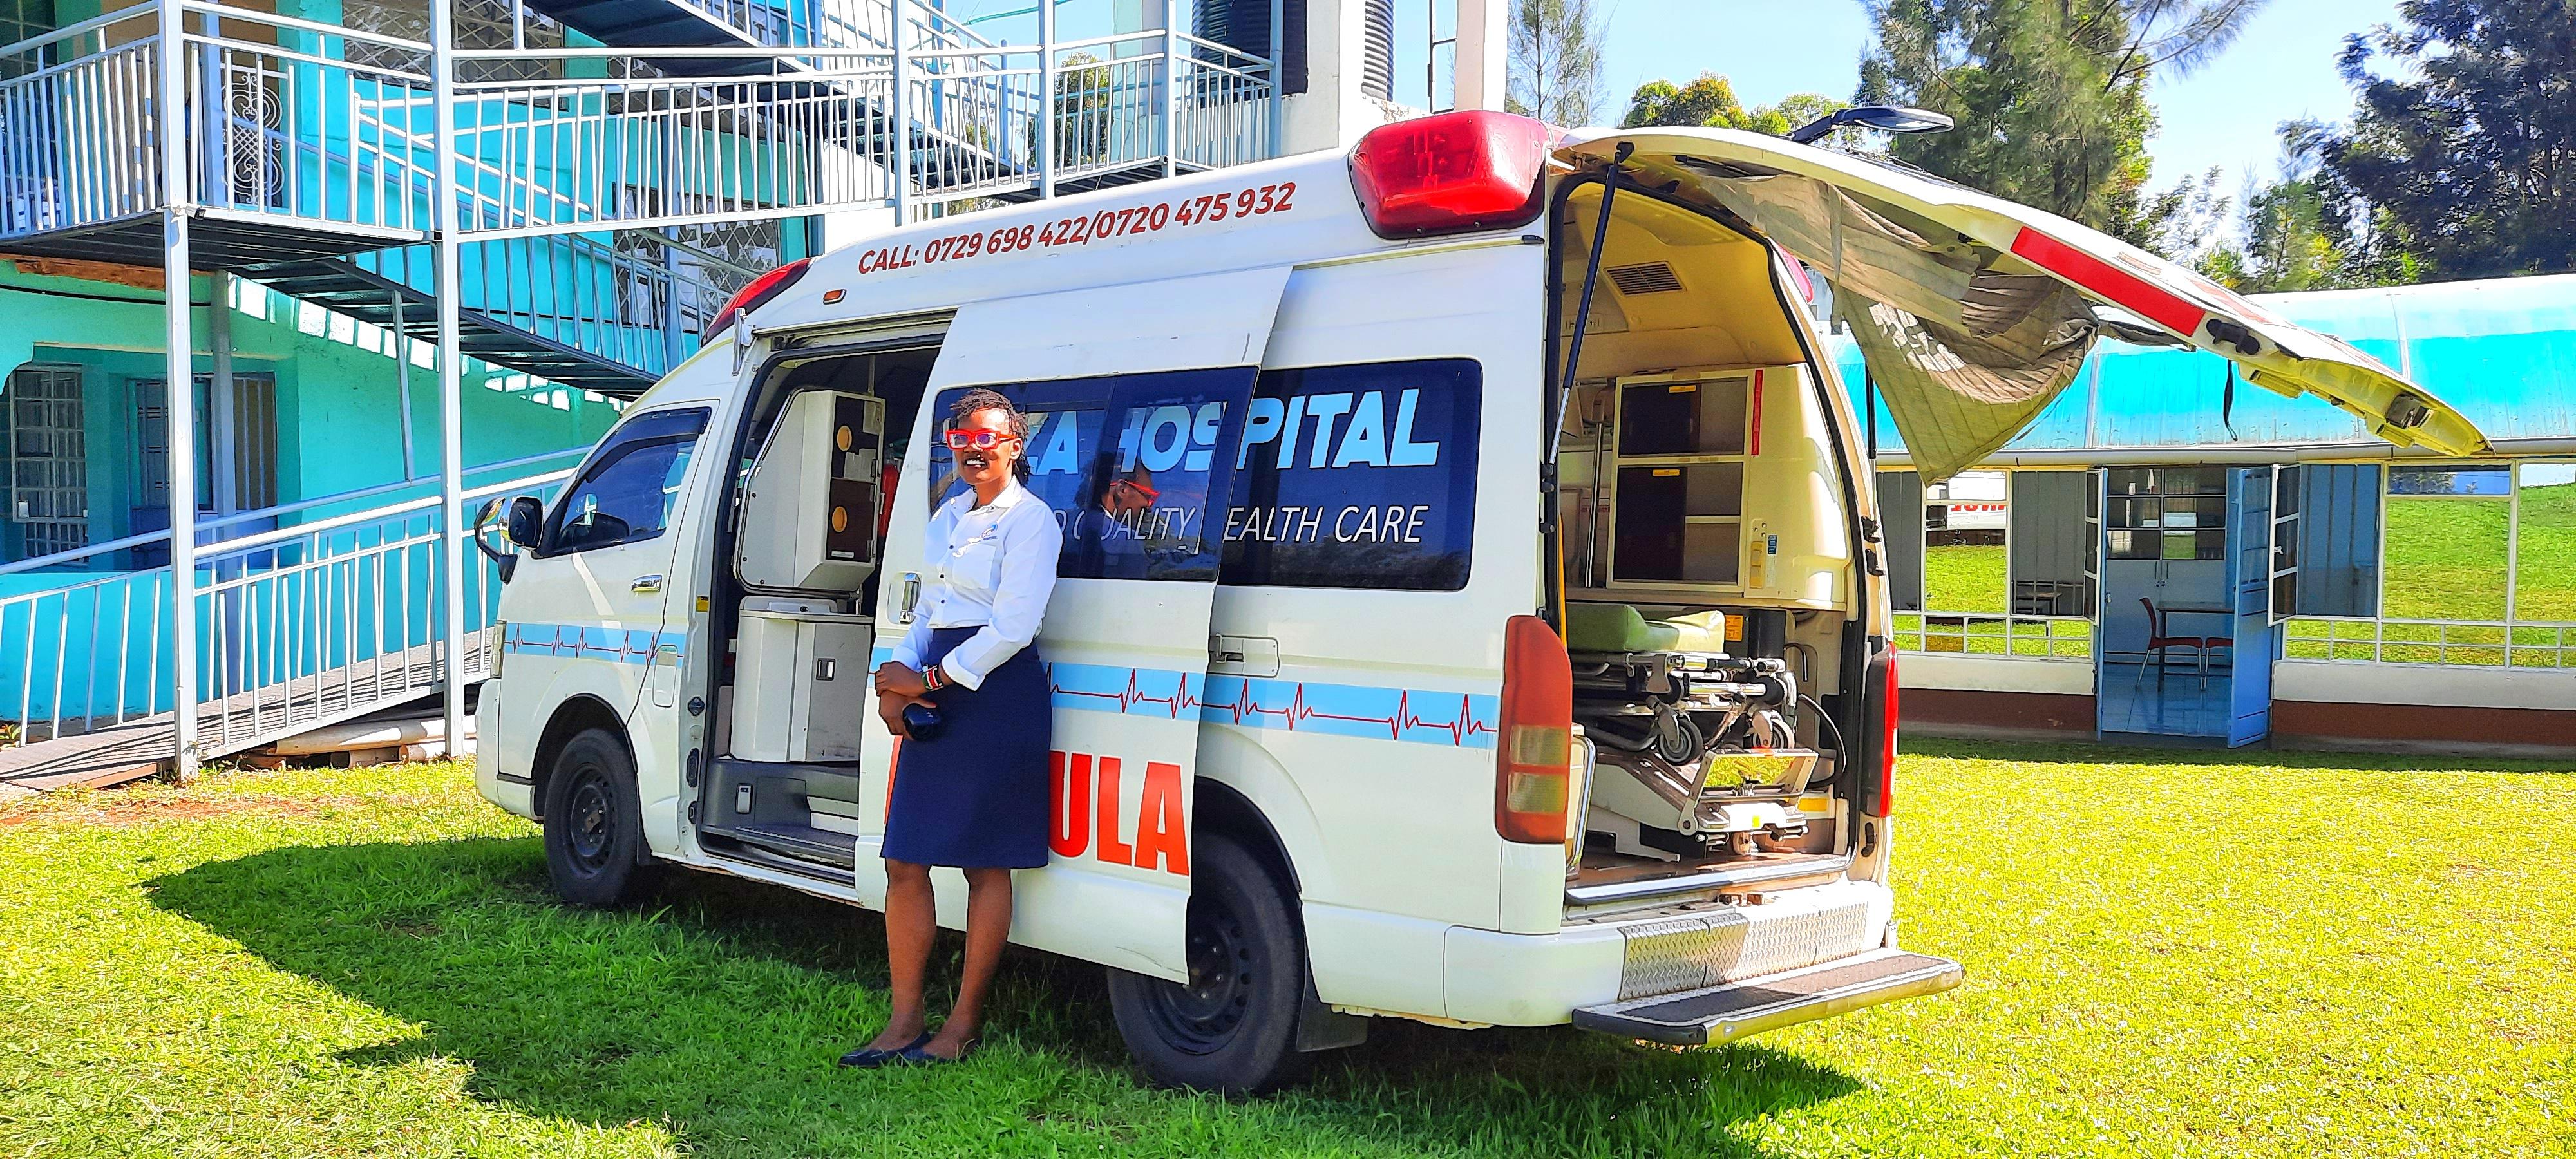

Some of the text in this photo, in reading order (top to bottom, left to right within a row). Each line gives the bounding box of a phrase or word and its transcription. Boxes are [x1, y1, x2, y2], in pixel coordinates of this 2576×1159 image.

[858, 182, 1296, 274] CALL: 0729 698 422/0720 475 932
[1223, 506, 1323, 542] EALTH
[1334, 505, 1430, 542] CARE
